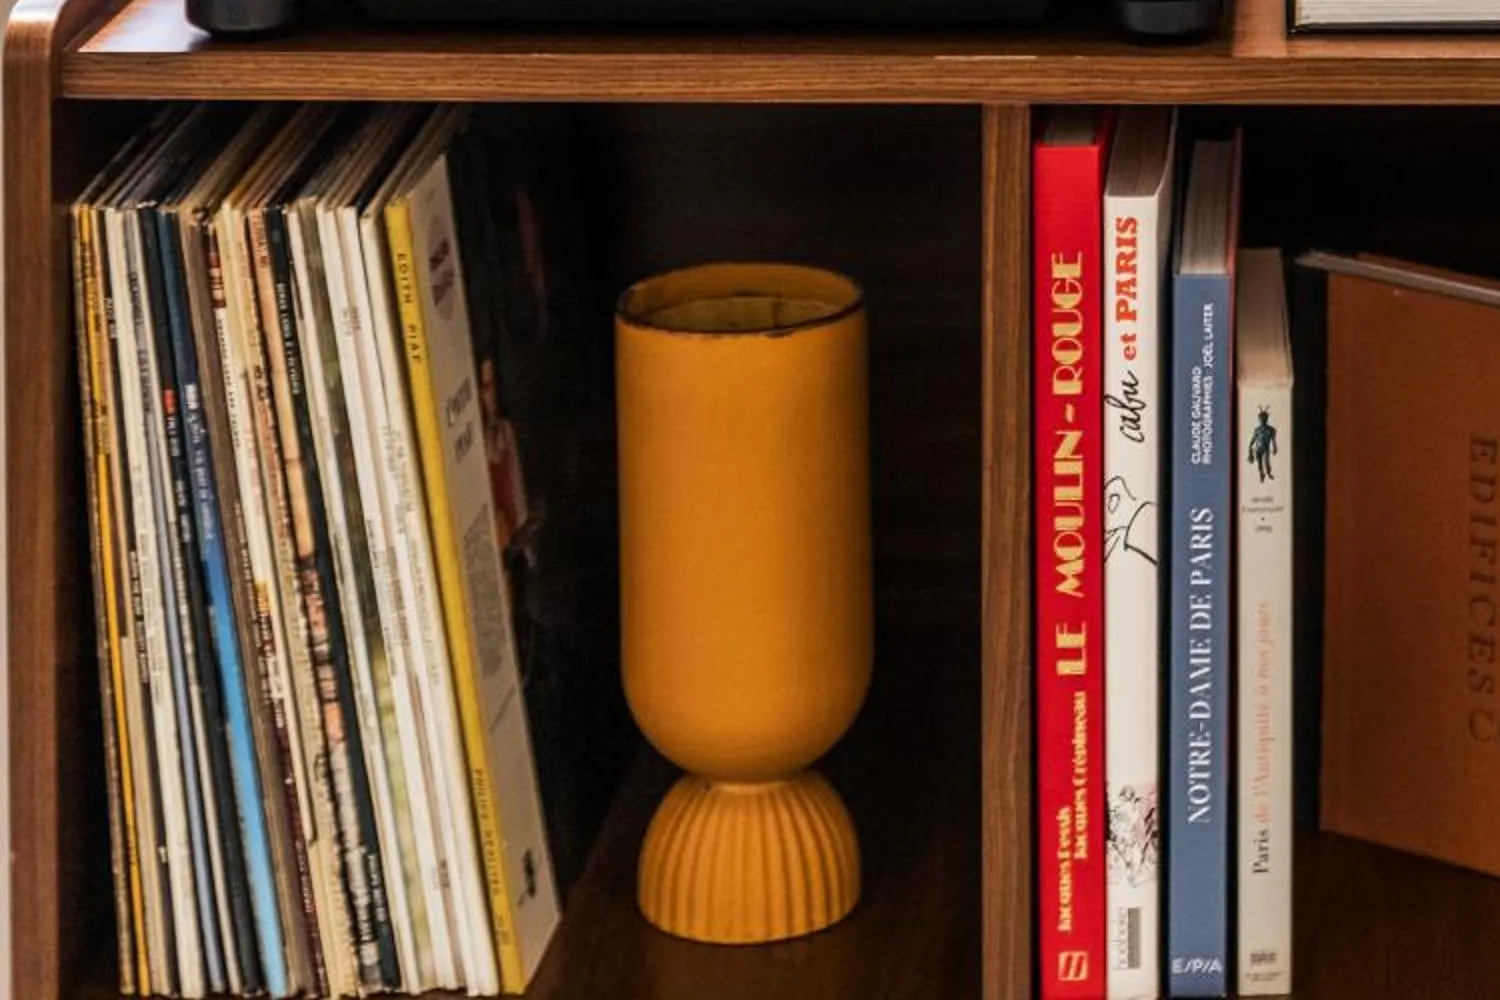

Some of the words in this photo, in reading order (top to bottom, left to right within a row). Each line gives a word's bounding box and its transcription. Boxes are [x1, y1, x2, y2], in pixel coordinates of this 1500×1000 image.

[1116, 216, 1139, 324] PARIS
[1122, 334, 1138, 361] et
[1192, 422, 1202, 465] CLAUDE
[1189, 507, 1215, 585] PARIS
[1468, 434, 1499, 698] EDIFICES
[1189, 594, 1213, 630] DE
[1056, 622, 1087, 675] LE
[1187, 638, 1213, 824] NOTRE-DAME
[1252, 829, 1270, 875] Paris
